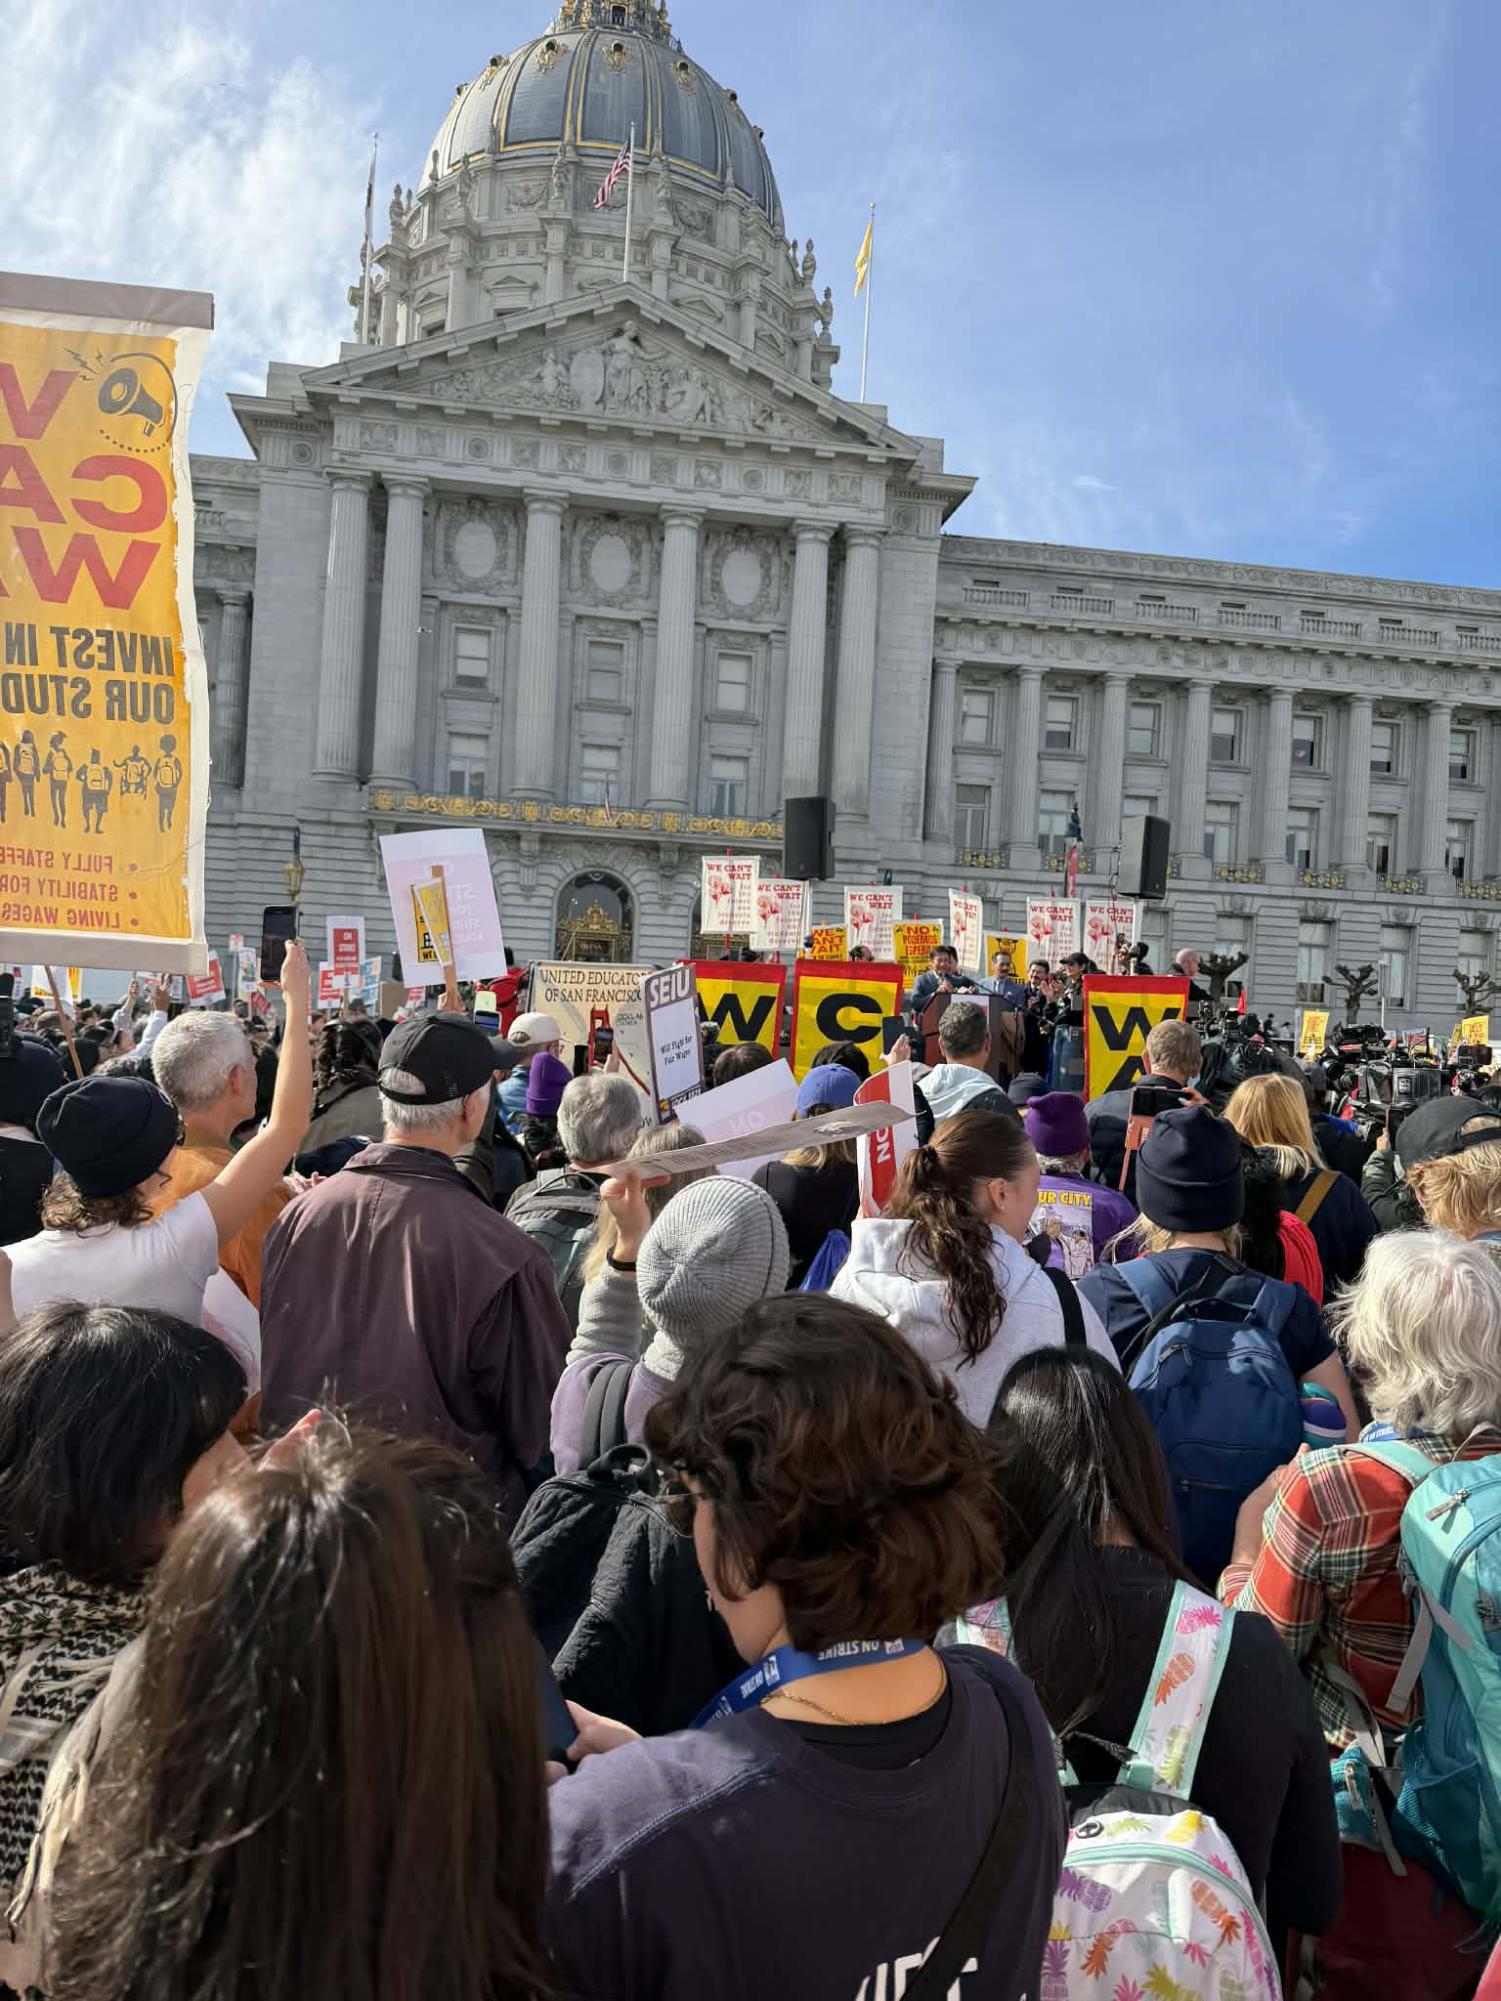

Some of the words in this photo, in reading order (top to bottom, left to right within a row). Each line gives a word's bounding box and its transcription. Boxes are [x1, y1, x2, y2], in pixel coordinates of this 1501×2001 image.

[707, 864, 722, 872] WE
[1047, 906, 1072, 914] CAN'T
[1050, 914, 1073, 922] WAIT
[1110, 916, 1134, 924] WAIT
[813, 928, 834, 936] WE
[906, 926, 930, 934] NO
[540, 970, 585, 985] UNITED
[587, 971, 650, 986] EDUCATO
[545, 988, 560, 1002] OF
[560, 988, 583, 1002] SAN
[650, 968, 690, 1009] SEIU
[697, 993, 776, 1042] W
[816, 993, 883, 1044] C
[1059, 1191, 1092, 1208] CITY
[817, 1640, 860, 1661] STRIKE
[862, 1640, 880, 1653] ON
